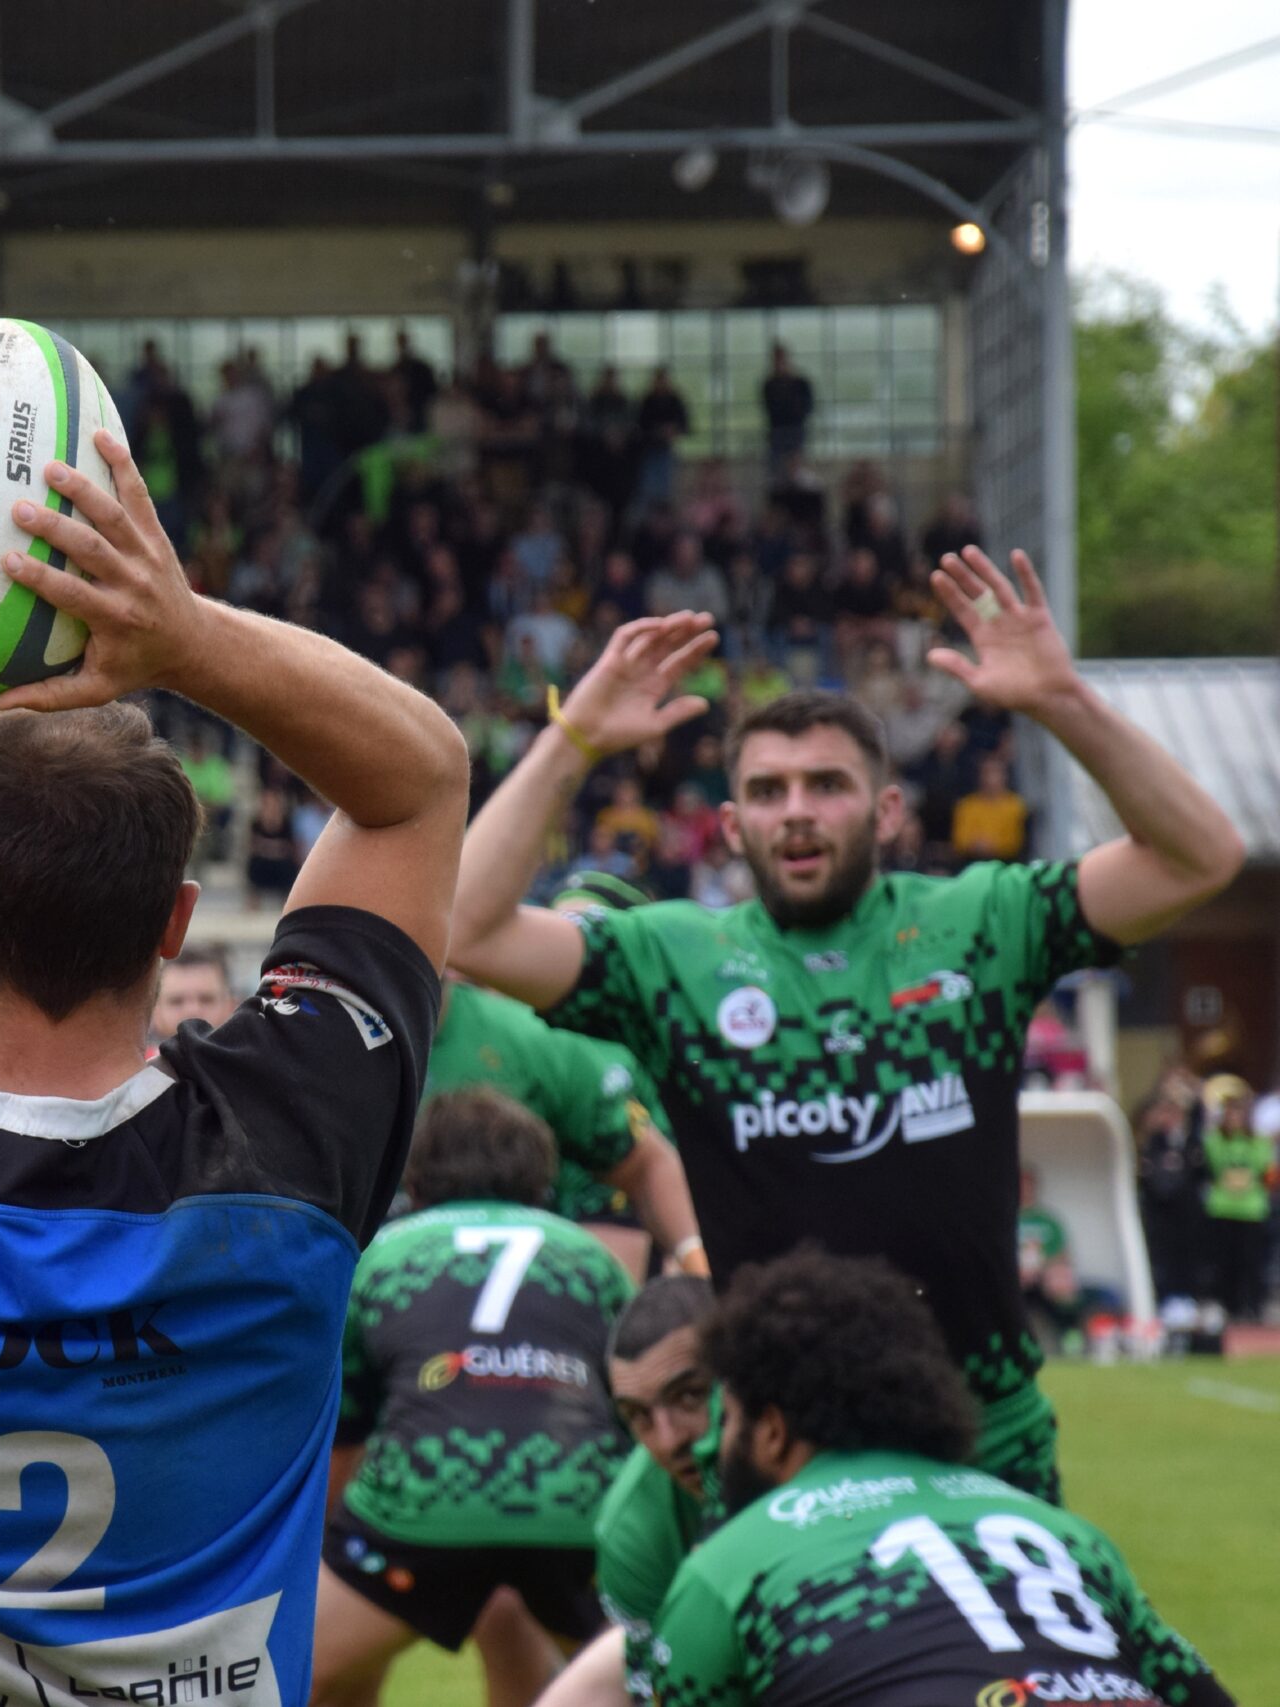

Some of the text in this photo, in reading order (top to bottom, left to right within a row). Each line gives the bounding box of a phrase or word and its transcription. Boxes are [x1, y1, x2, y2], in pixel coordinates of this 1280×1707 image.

[25, 406, 38, 464] MATCHBALL
[732, 1071, 970, 1152] picoty AVIA
[453, 1225, 545, 1334] 7
[870, 1514, 1119, 1660] 18
